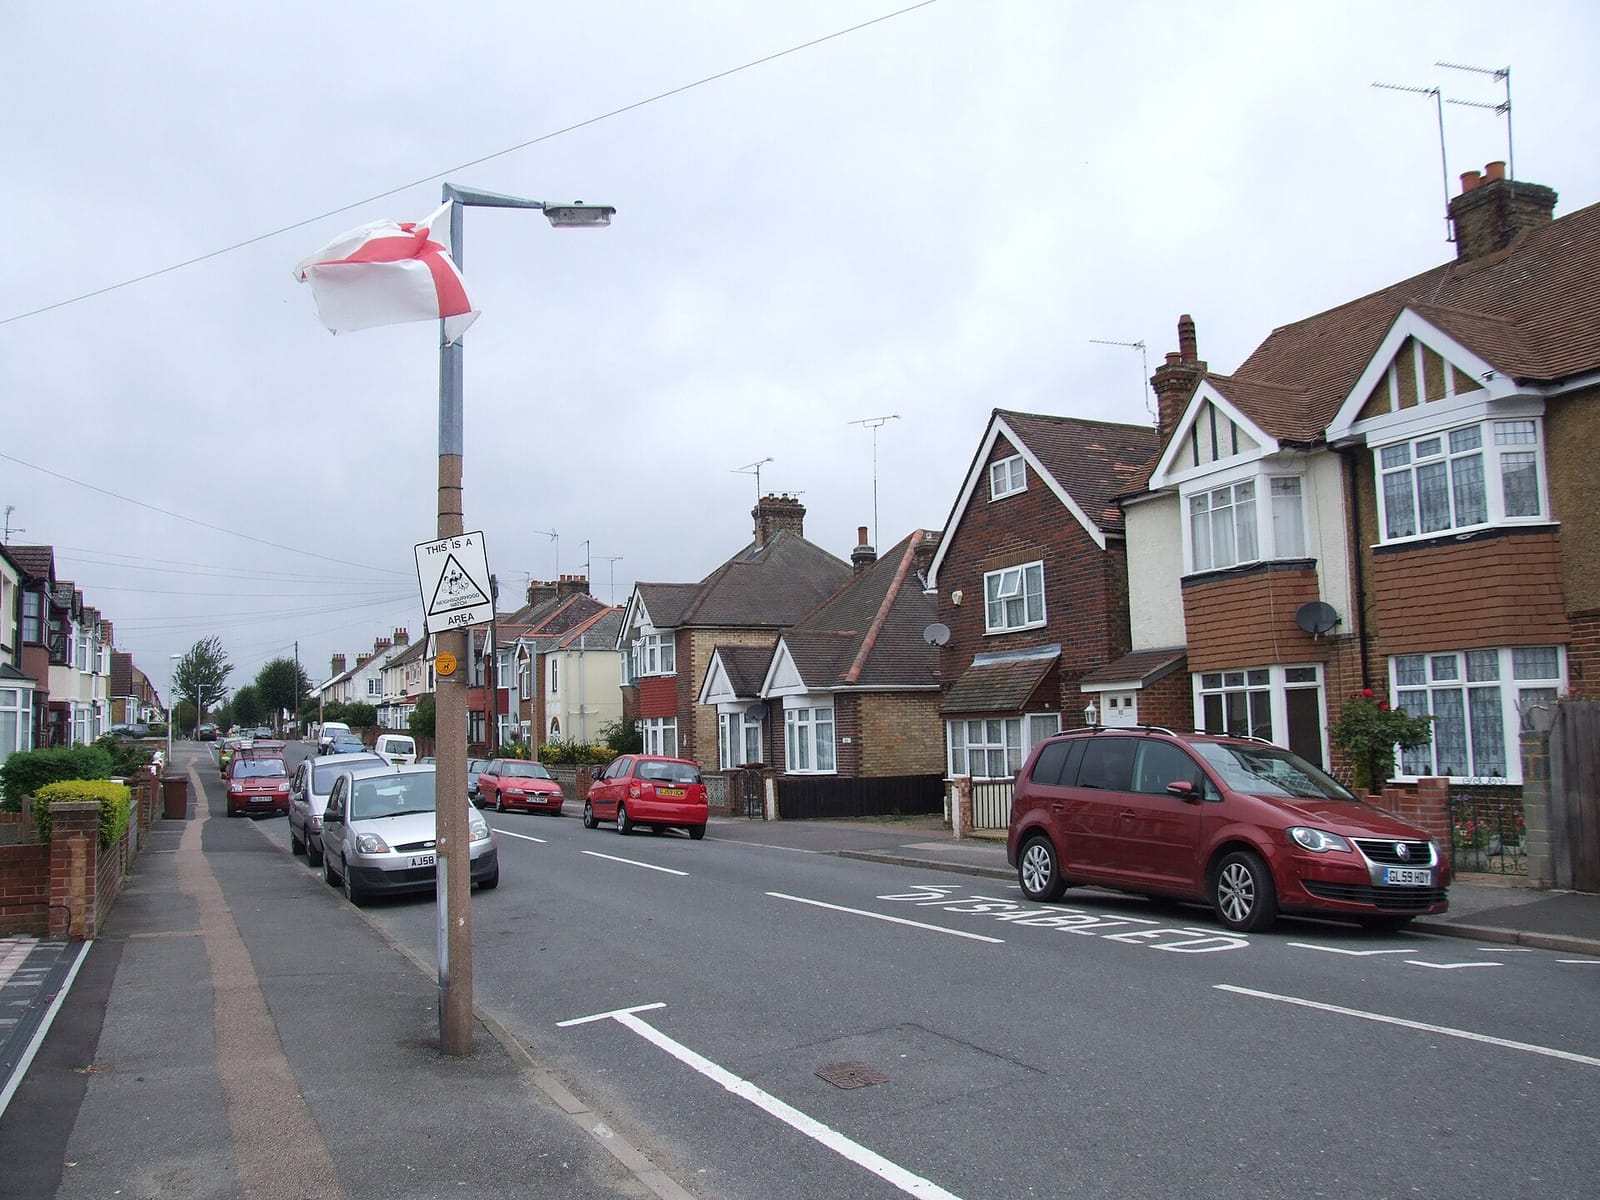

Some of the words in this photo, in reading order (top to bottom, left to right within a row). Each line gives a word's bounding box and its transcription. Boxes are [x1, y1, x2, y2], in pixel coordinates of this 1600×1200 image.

[426, 543, 447, 555] THIS
[451, 540, 461, 549] IS
[466, 538, 473, 546] A
[436, 592, 480, 606] NEIGHBOURHOOD
[447, 613, 475, 625] AREA
[411, 855, 434, 866] AJ58
[1389, 870, 1413, 883] GL59
[876, 892, 1250, 953] DISABLED
